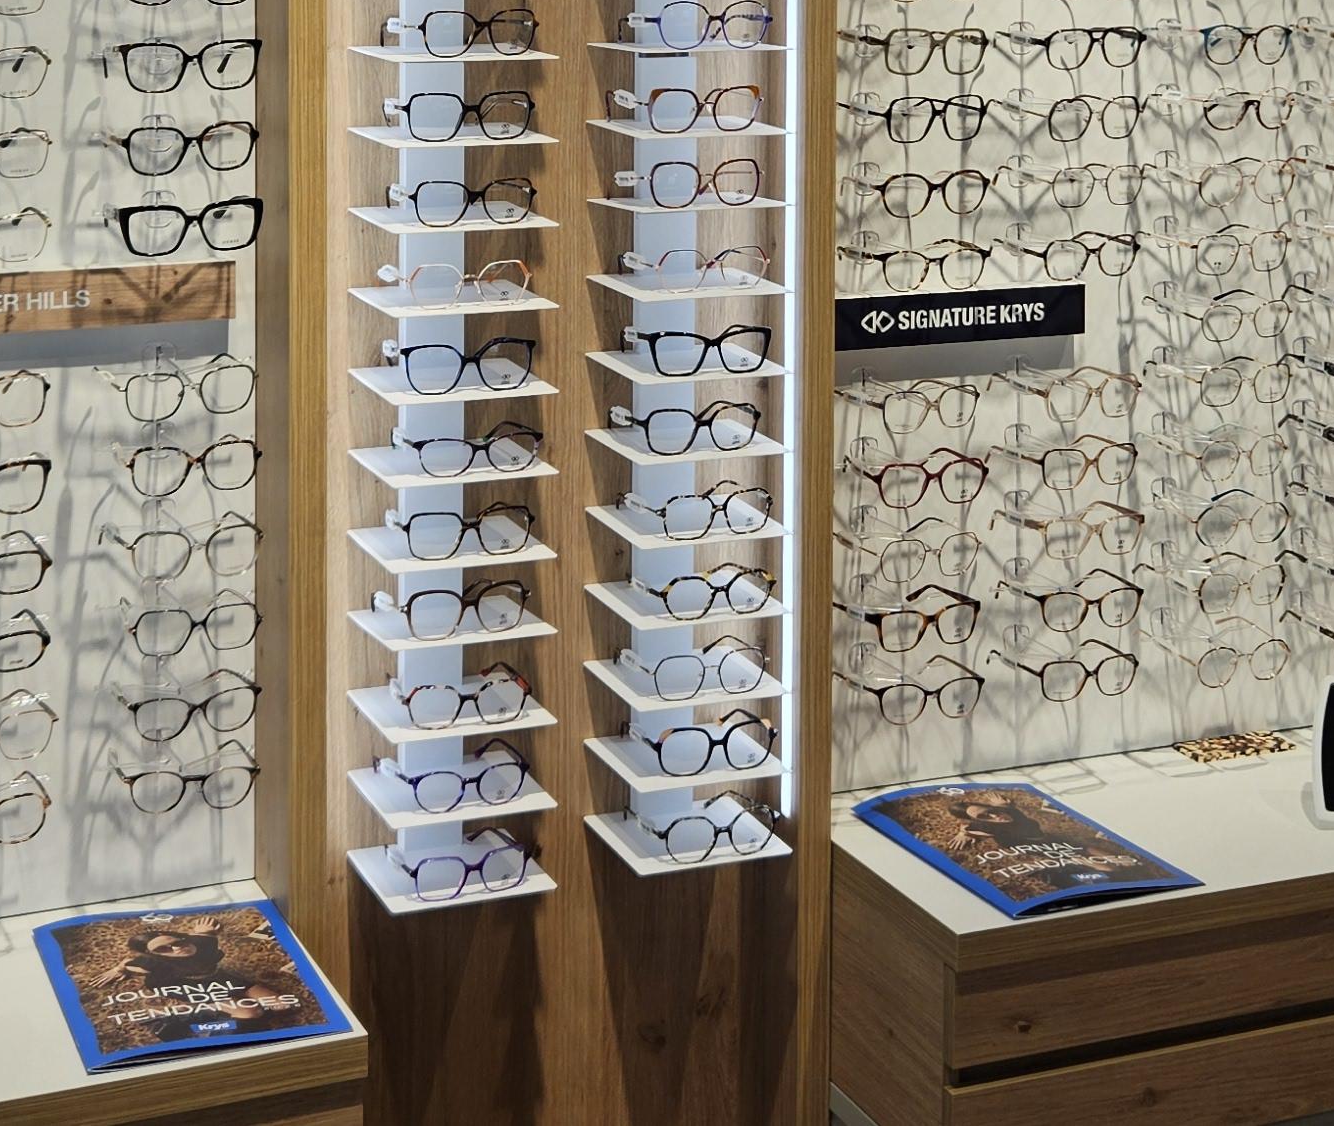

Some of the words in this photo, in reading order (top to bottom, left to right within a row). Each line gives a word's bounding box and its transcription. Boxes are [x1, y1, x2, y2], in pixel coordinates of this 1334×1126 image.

[26, 289, 91, 311] HILLS
[897, 306, 996, 331] SIGNATURE
[999, 303, 1045, 326] KRYS
[975, 842, 1083, 865] JOURNAL
[101, 980, 246, 1007] JOURNAL
[187, 991, 232, 1004] DE
[107, 994, 300, 1025] TENDANCES
